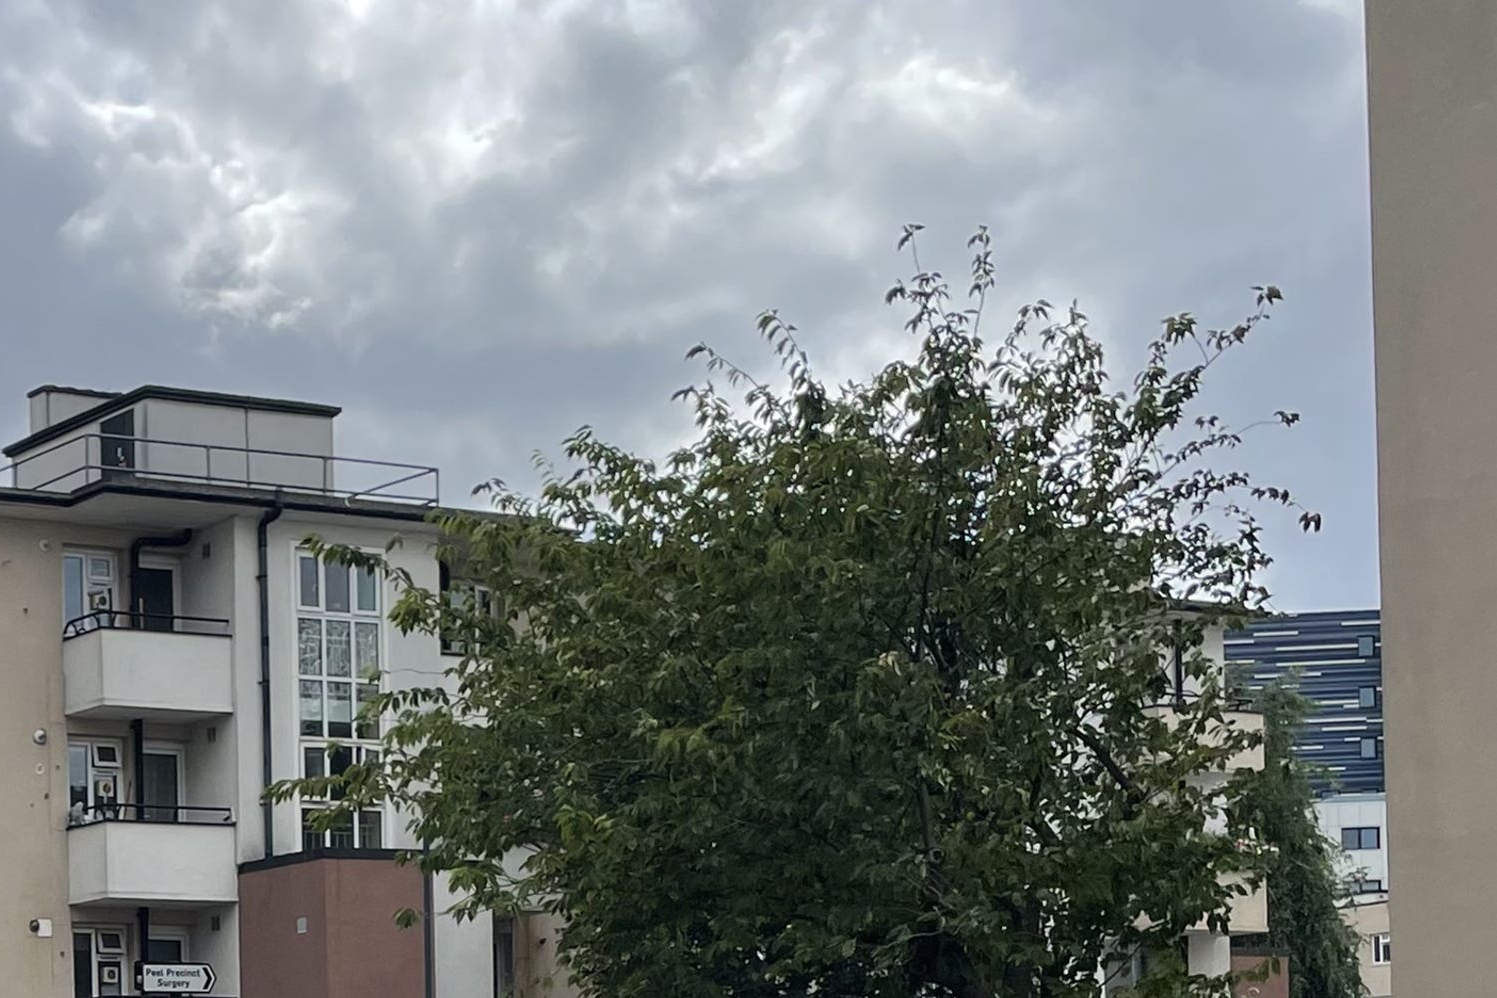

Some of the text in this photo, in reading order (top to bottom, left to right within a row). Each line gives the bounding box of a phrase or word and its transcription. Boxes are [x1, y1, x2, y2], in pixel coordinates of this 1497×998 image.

[145, 968, 201, 977] Peel Precinct
[157, 978, 191, 989] Surgery
